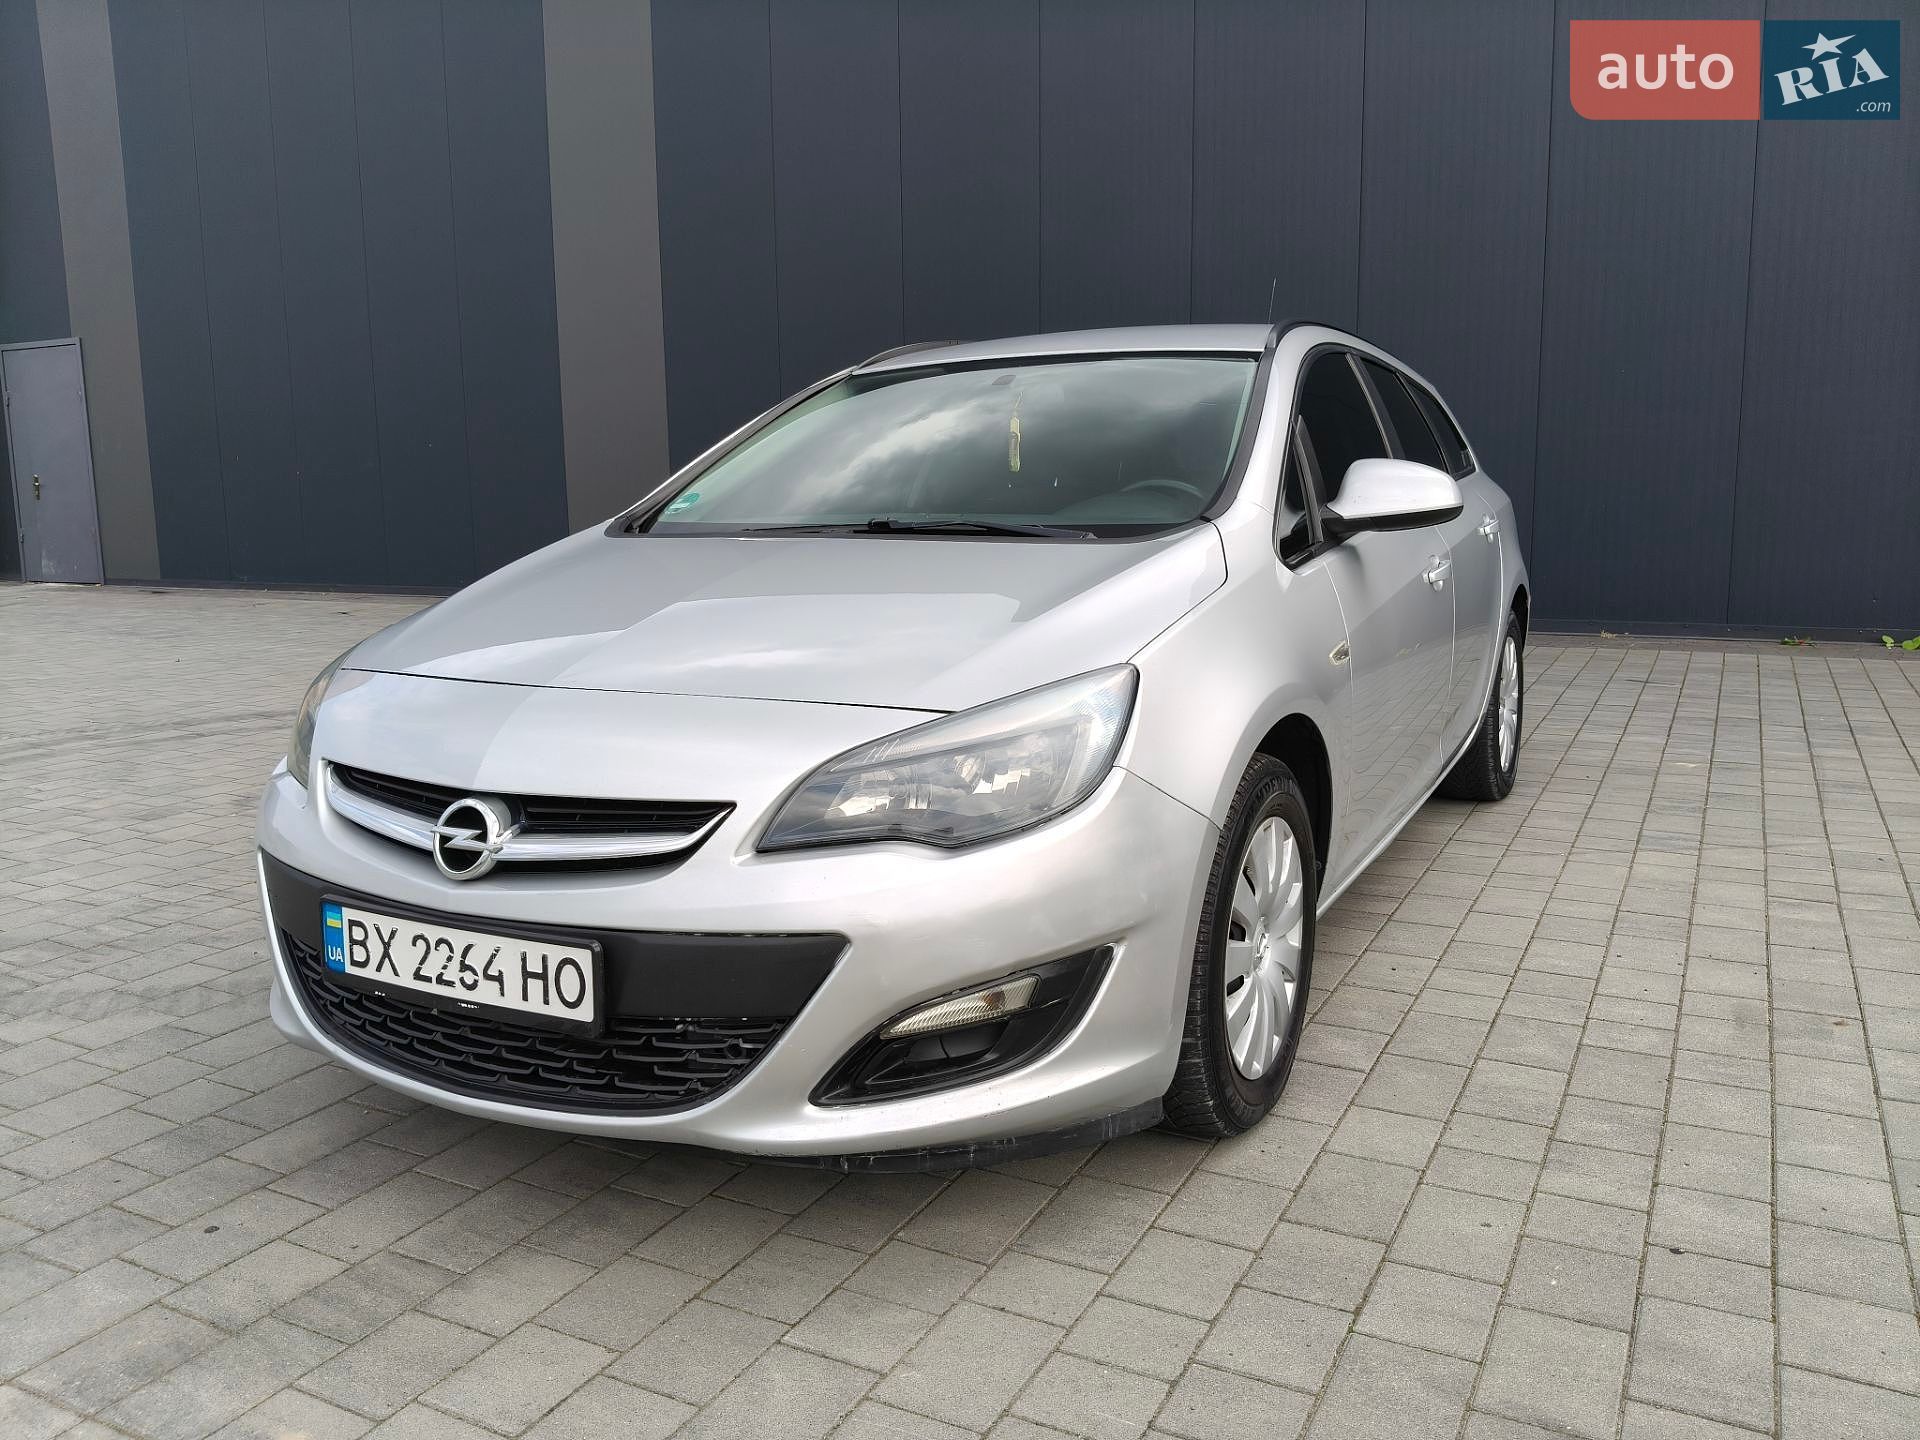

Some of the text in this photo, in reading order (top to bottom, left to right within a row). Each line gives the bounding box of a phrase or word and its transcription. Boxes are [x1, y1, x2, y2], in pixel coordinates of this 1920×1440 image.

[328, 947, 344, 963] UA
[347, 918, 586, 1010] BX 2264 HO
